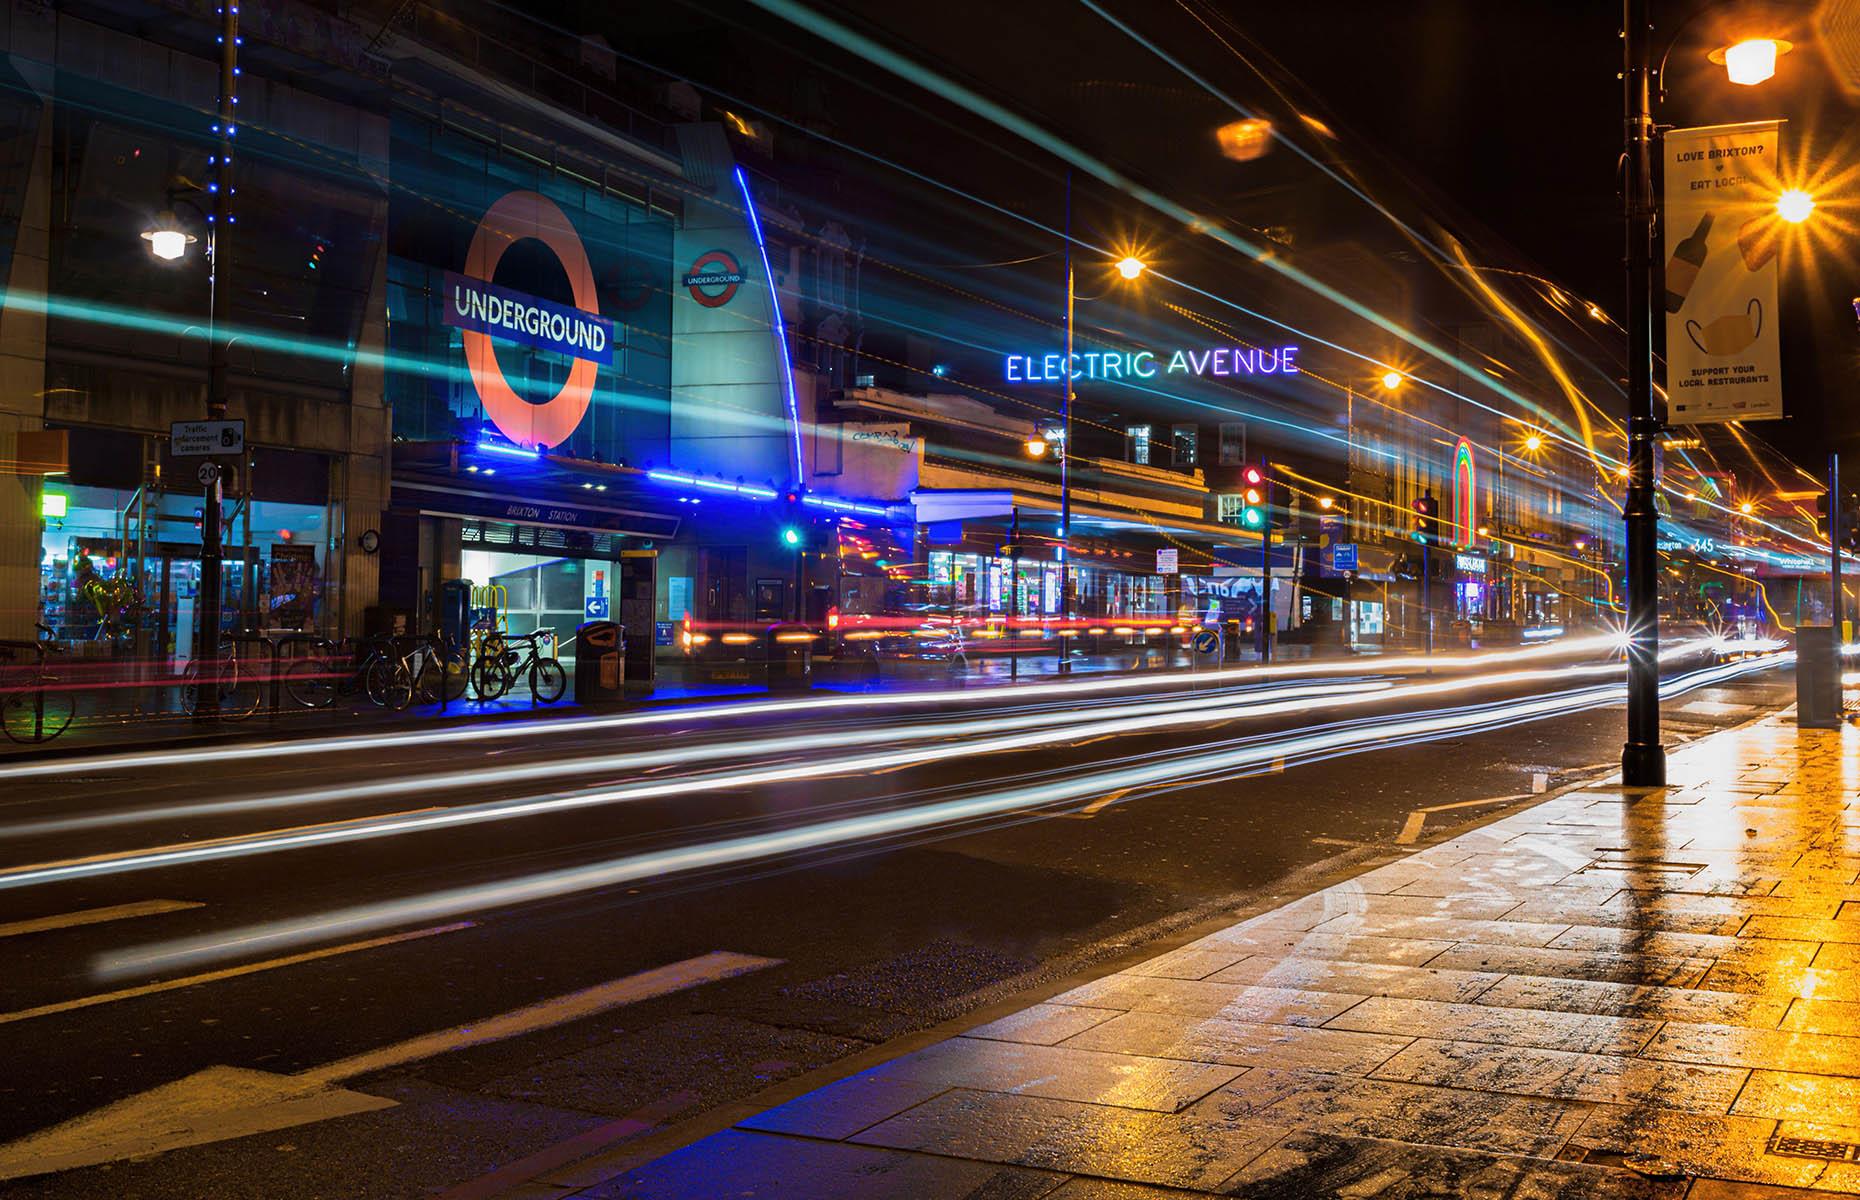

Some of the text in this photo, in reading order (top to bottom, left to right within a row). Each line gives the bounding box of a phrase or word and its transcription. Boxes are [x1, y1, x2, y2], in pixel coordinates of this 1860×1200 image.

[1677, 145, 1764, 162] LOVE BRIXTON?
[1690, 180, 1713, 191] EAT
[687, 275, 741, 285] UNDERGROUND
[455, 285, 606, 352] UNDERGROUND
[1006, 347, 1298, 381] ELECTRIC AVENUE
[1691, 365, 1755, 377] SUPPORT YOUR
[1679, 375, 1769, 388] LOCAL RESTAURANTS
[184, 425, 208, 434] Traffic
[180, 445, 210, 453] cameras
[199, 467, 216, 480] 20
[506, 504, 578, 522] BRIXTON STATION
[1694, 538, 1714, 552] 345
